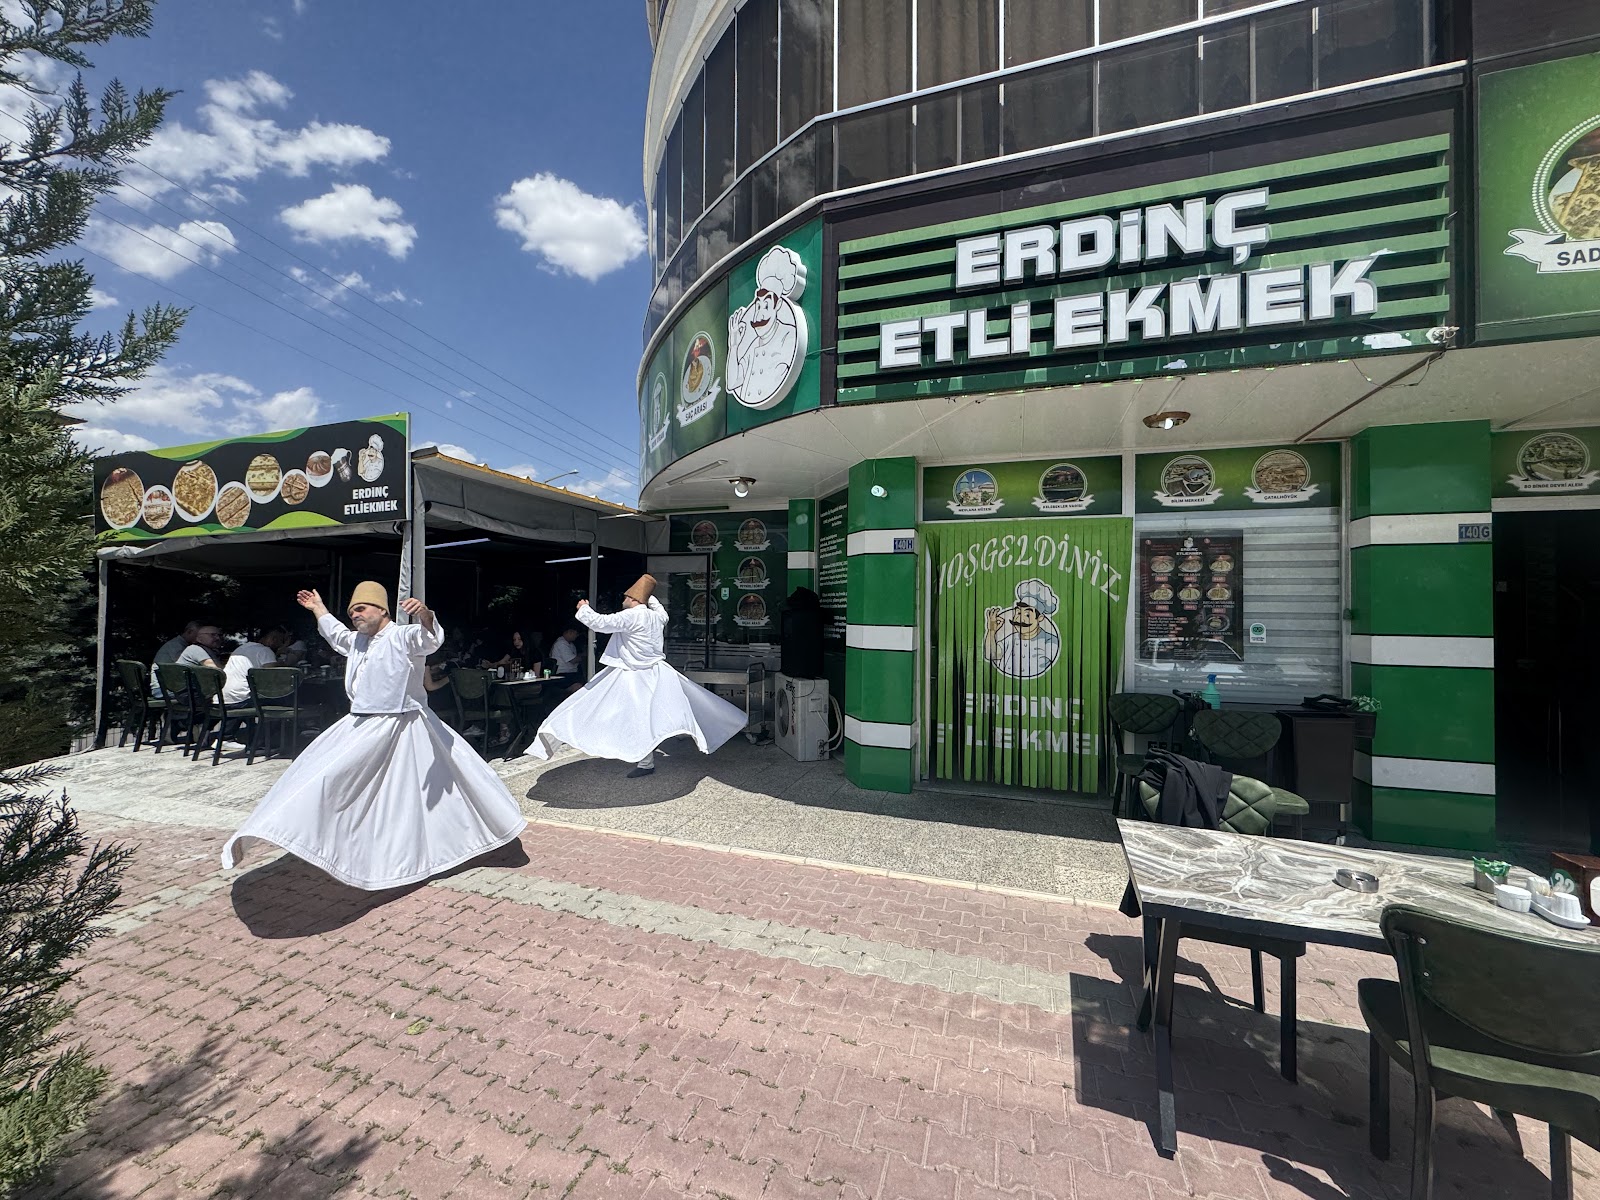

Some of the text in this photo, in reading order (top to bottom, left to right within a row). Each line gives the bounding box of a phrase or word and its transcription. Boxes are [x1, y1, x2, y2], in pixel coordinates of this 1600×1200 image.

[955, 186, 1270, 292] ERDİNÇ
[1556, 247, 1600, 267] SAD
[693, 402, 708, 416] ARASI
[352, 485, 389, 500] ERDİNÇ
[344, 500, 398, 515] ETLİEKMEK
